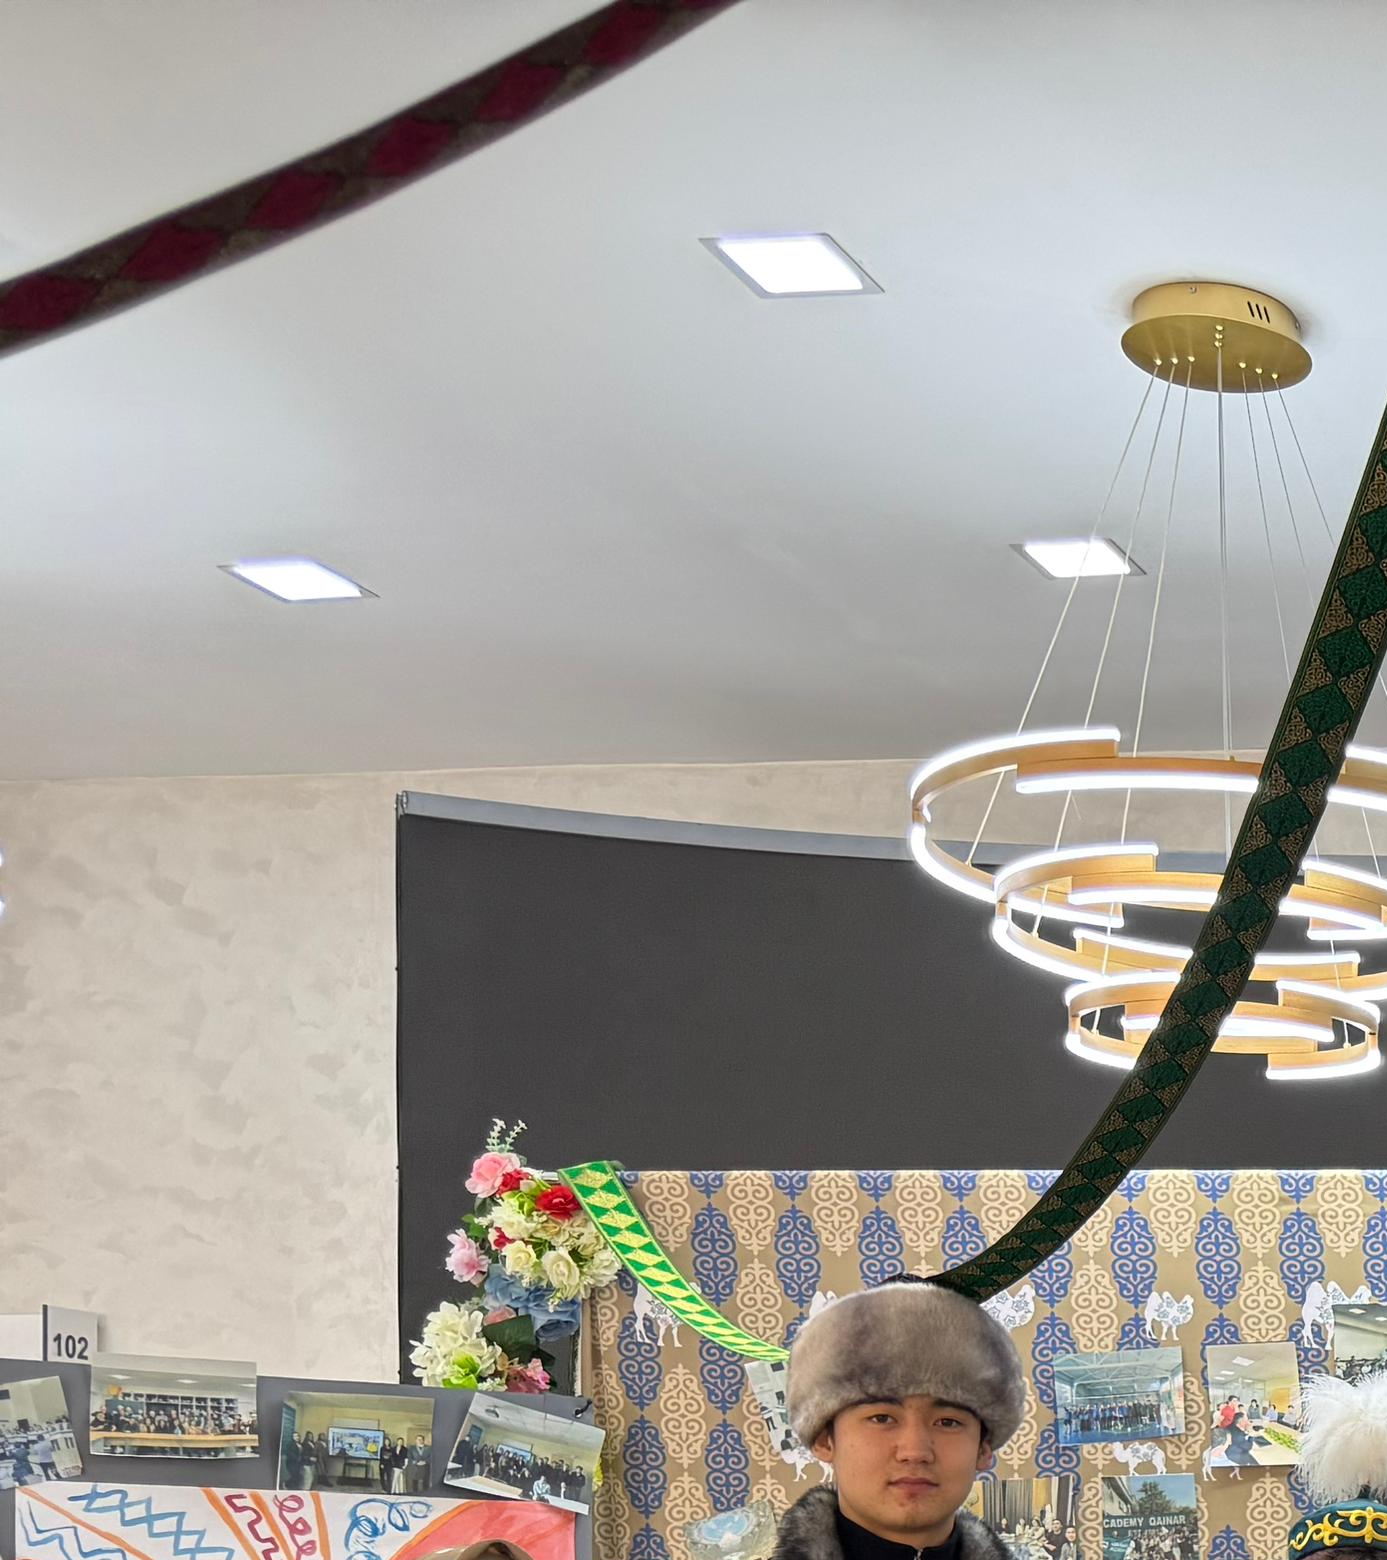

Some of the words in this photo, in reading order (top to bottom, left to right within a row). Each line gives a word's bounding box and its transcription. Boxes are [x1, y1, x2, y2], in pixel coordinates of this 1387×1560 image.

[53, 1333, 89, 1361] 102
[1103, 1517, 1144, 1528] CADEMY
[1149, 1514, 1186, 1526] QAINAR
